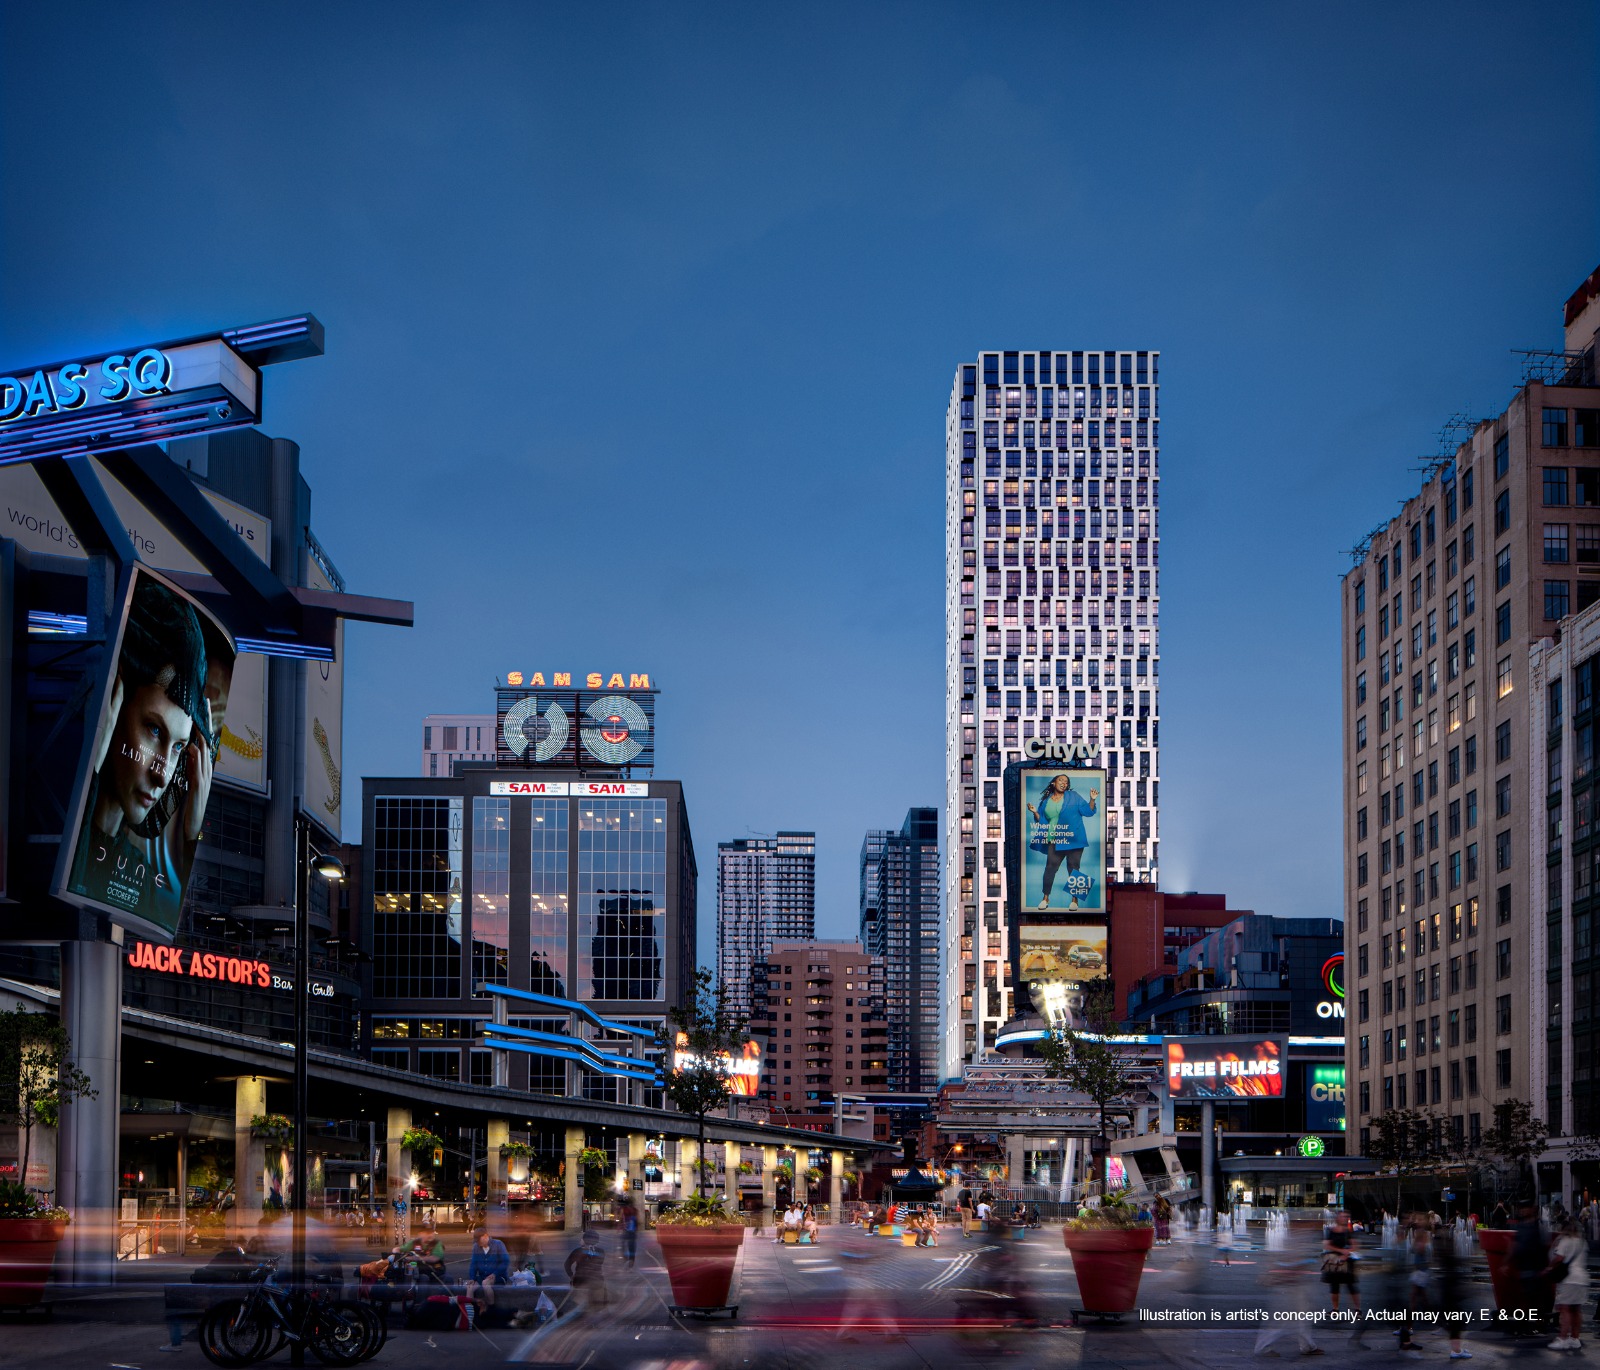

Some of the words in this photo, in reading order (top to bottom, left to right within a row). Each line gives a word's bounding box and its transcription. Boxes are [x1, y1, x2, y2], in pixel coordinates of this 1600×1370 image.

[0, 363, 85, 419] DAS
[100, 348, 170, 399] SQ
[8, 507, 79, 549] world's
[507, 672, 571, 686] SAM
[587, 673, 650, 688] SAM
[121, 743, 147, 765] LADY
[1024, 737, 1101, 762] Citytv
[509, 783, 546, 793] SAM
[588, 784, 626, 794] SAM
[1067, 875, 1092, 888] 98.1
[106, 886, 132, 902] OCTOBER
[131, 895, 139, 905] 22
[128, 942, 183, 974] JACK
[189, 951, 271, 987] ASTOR'S
[272, 975, 293, 991] Bar
[312, 982, 335, 997] Grill
[1030, 982, 1080, 990] Panic
[1170, 1061, 1216, 1077] FREE
[1220, 1060, 1280, 1077] FILMS
[1307, 1141, 1319, 1152] P
